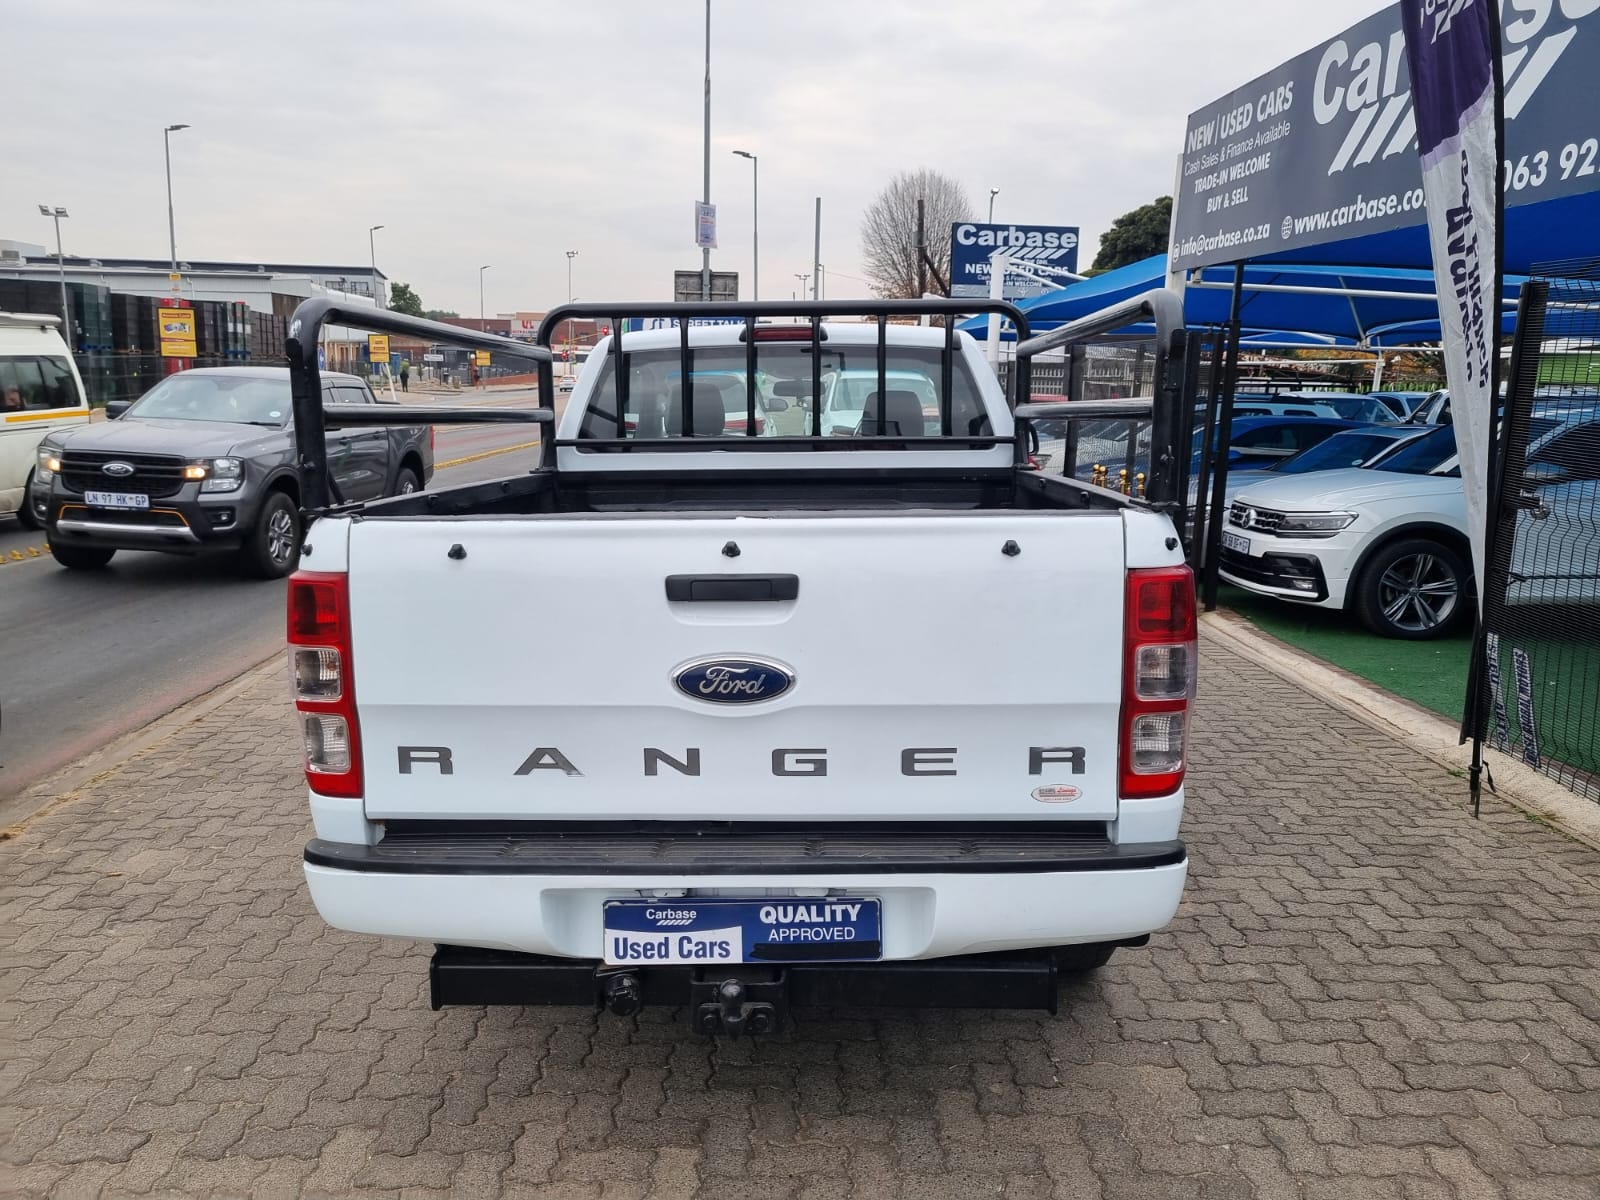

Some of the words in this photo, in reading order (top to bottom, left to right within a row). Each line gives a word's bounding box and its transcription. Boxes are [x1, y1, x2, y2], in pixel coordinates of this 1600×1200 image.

[1187, 120, 1215, 154] NEW
[1221, 103, 1253, 139] USED
[1257, 81, 1294, 122] CARS
[1184, 159, 1201, 176] Cash
[1201, 152, 1219, 170] Sales
[1220, 147, 1226, 162] &
[1226, 137, 1253, 159] Finance
[1254, 120, 1291, 149] Available
[1194, 166, 1229, 194] TRADE-IN
[1229, 152, 1271, 181] WELCOME
[1206, 194, 1224, 214] BUY
[1223, 193, 1229, 208] &
[1231, 186, 1249, 206] SELL
[957, 224, 1078, 248] Carbase
[1181, 223, 1270, 257] info@carbase.co.za
[699, 666, 766, 694] Ford
[398, 746, 1086, 776] RANGER
[646, 908, 697, 920] Carbase
[760, 904, 862, 924] QUALITY
[614, 937, 670, 960] Used
[678, 936, 731, 960] Cars
[768, 927, 856, 942] APPROVED
